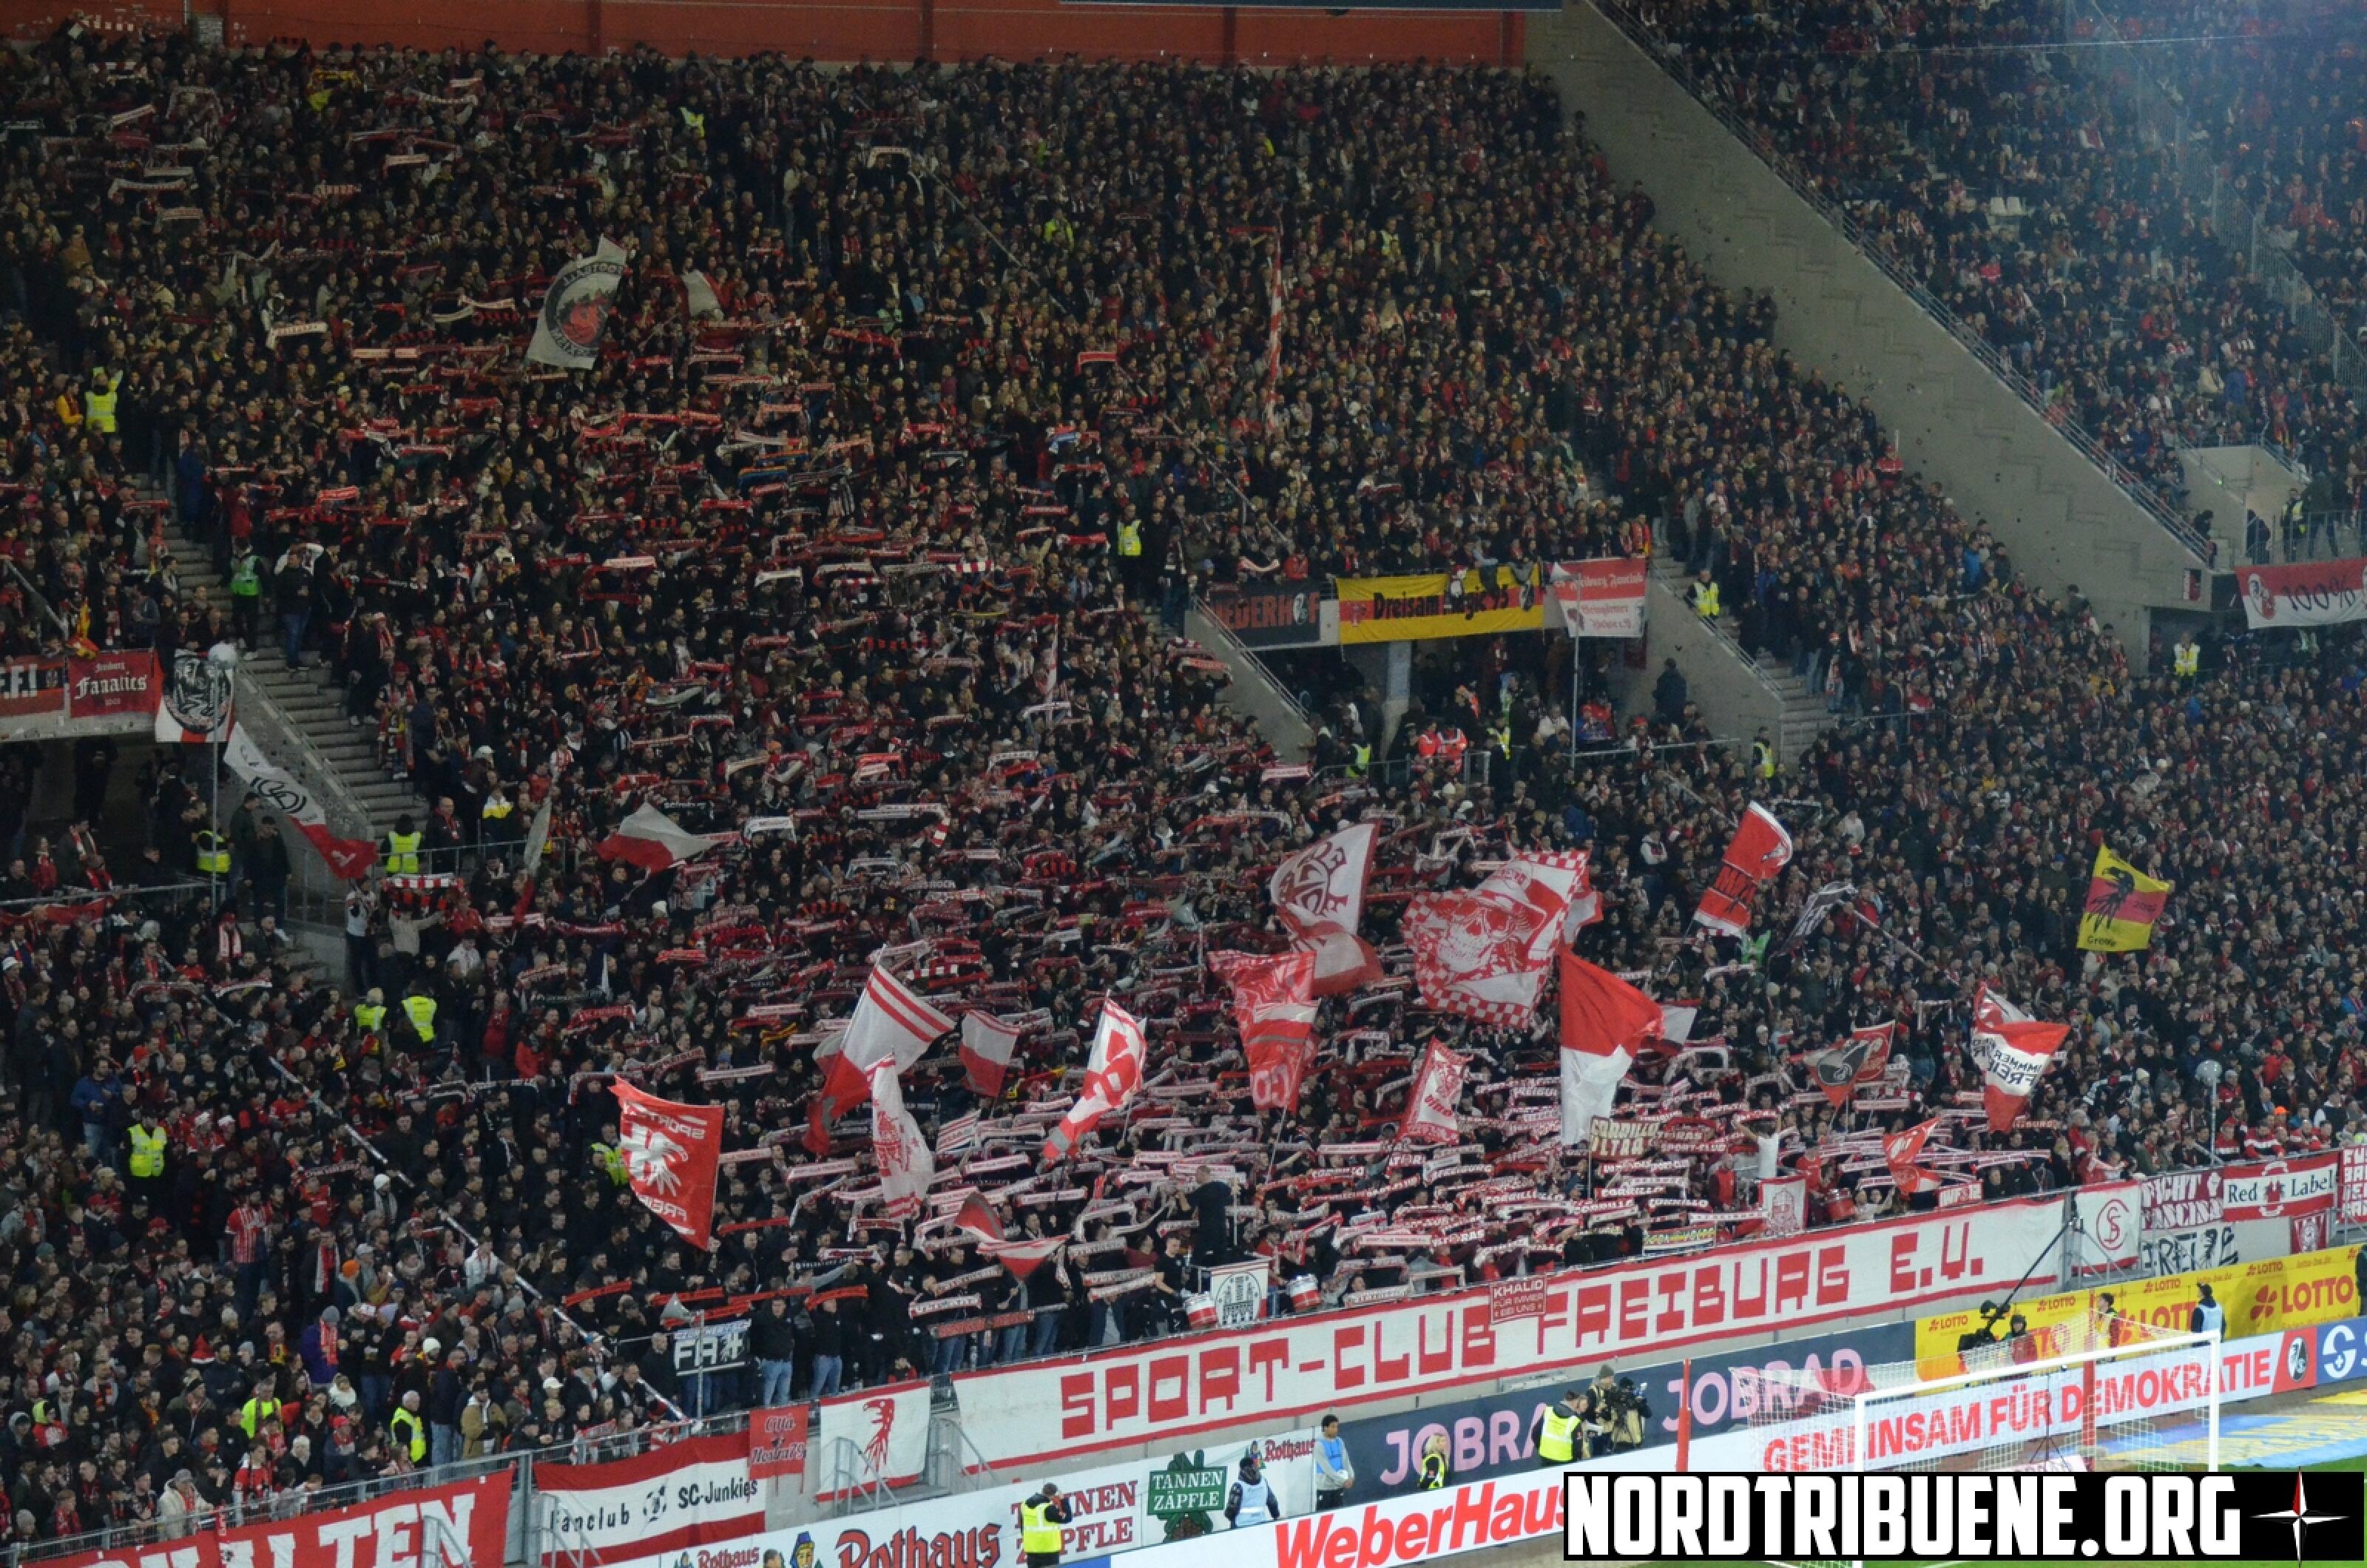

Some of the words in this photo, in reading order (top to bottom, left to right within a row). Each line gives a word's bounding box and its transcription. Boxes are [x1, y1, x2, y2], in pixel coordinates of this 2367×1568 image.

[2282, 575, 2356, 611] 100%
[1373, 592, 1439, 620] Dreisam
[74, 671, 148, 699] Fanatics
[2228, 1183, 2258, 1204] Red
[2291, 1169, 2334, 1197] Label
[2257, 1260, 2283, 1274] LOTTO
[1493, 1279, 1544, 1298] KHALID
[2155, 1278, 2181, 1292] LOTTO
[2282, 1274, 2354, 1314] LOTTO
[1494, 1298, 1513, 1308] FÜR
[1514, 1293, 1544, 1305] IMMER
[1516, 1302, 1536, 1313] UNS
[2048, 1295, 2076, 1309] LOTTO
[1940, 1315, 1968, 1329] LOTTO
[2140, 1302, 2198, 1336] LOTT
[1061, 1305, 1495, 1440] SPORT-CLUB
[1537, 1245, 1849, 1355] FREIBURG
[1988, 1384, 2050, 1435] FÜR
[2060, 1349, 2272, 1419] DEMOKRATIE
[1264, 1438, 1316, 1463] Rothaus
[1152, 1470, 1223, 1491] TANNEN
[550, 1502, 631, 1533] Fanclub
[678, 1479, 758, 1510] SC-Junkies
[1152, 1488, 1221, 1513] ZÄPFLE
[698, 1546, 761, 1568] Rothaus
[834, 1522, 1002, 1568] Rothaus
